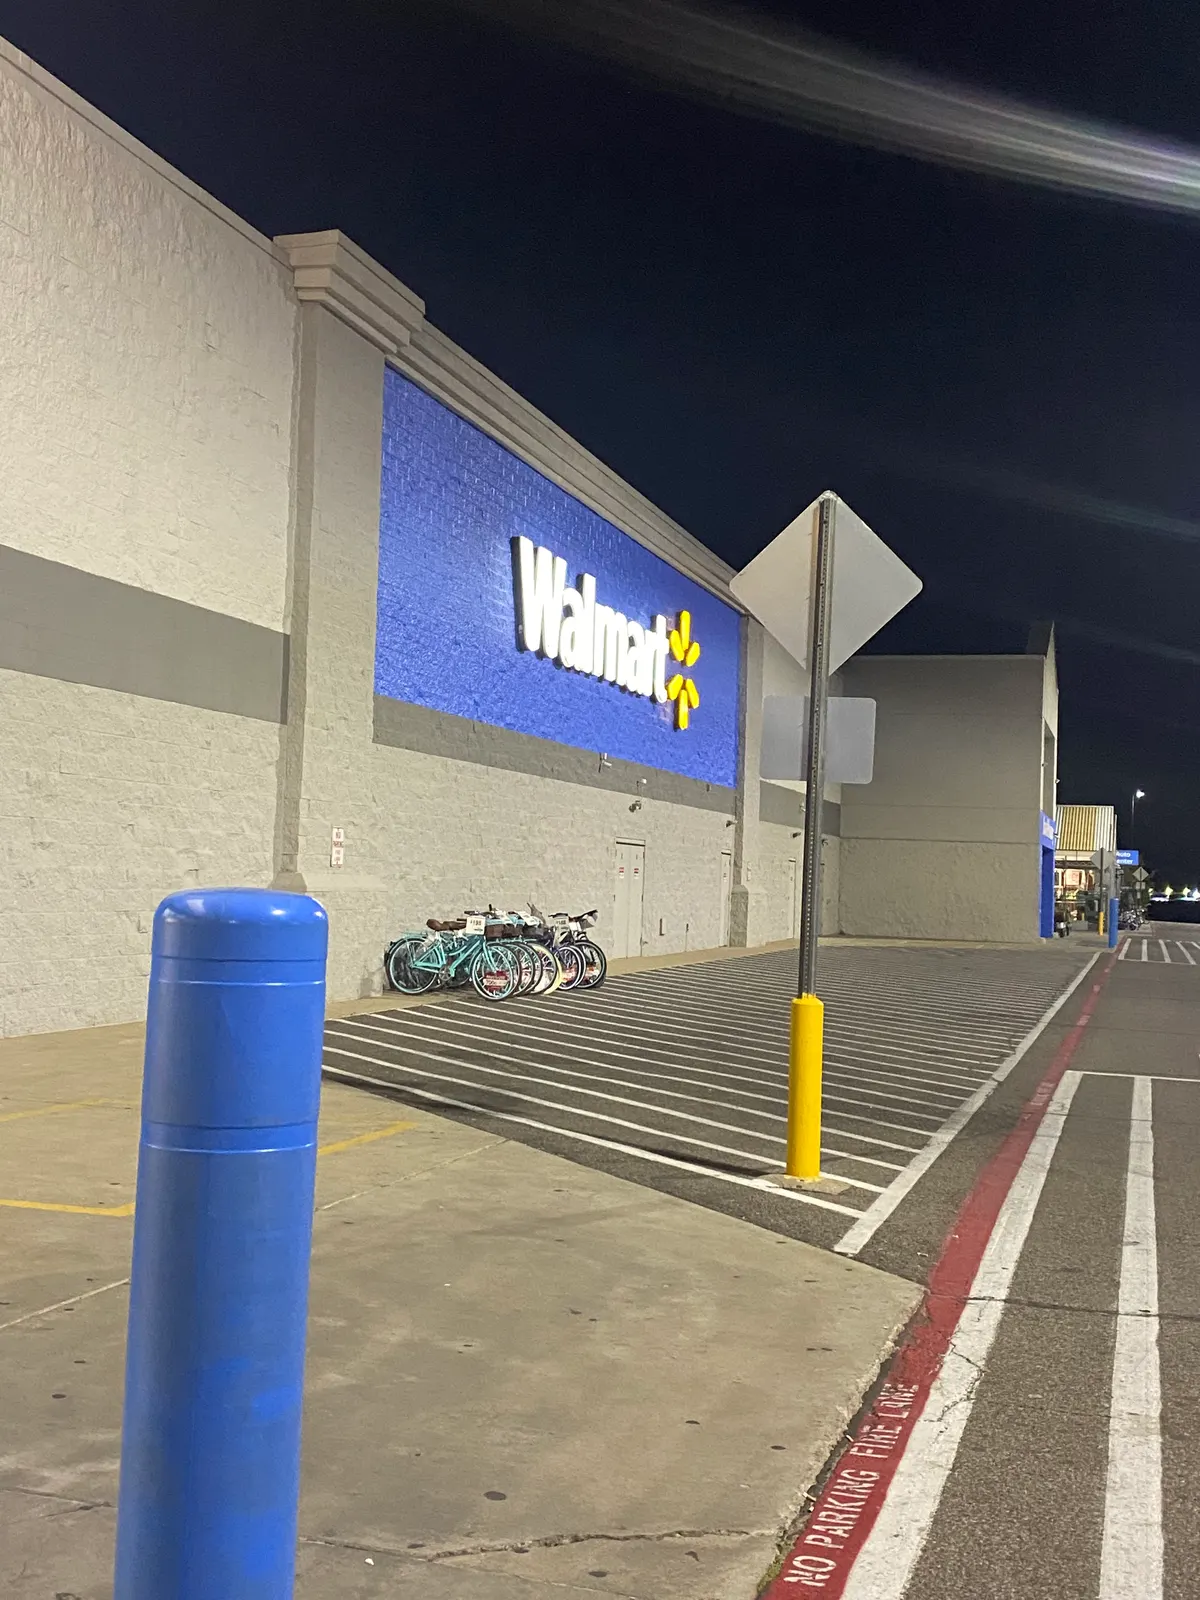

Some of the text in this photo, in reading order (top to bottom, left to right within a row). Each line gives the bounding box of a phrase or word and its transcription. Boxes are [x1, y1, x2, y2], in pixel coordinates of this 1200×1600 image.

[514, 536, 669, 703] Walmart
[784, 1383, 919, 1587] NO PARKING FIRE LANE
